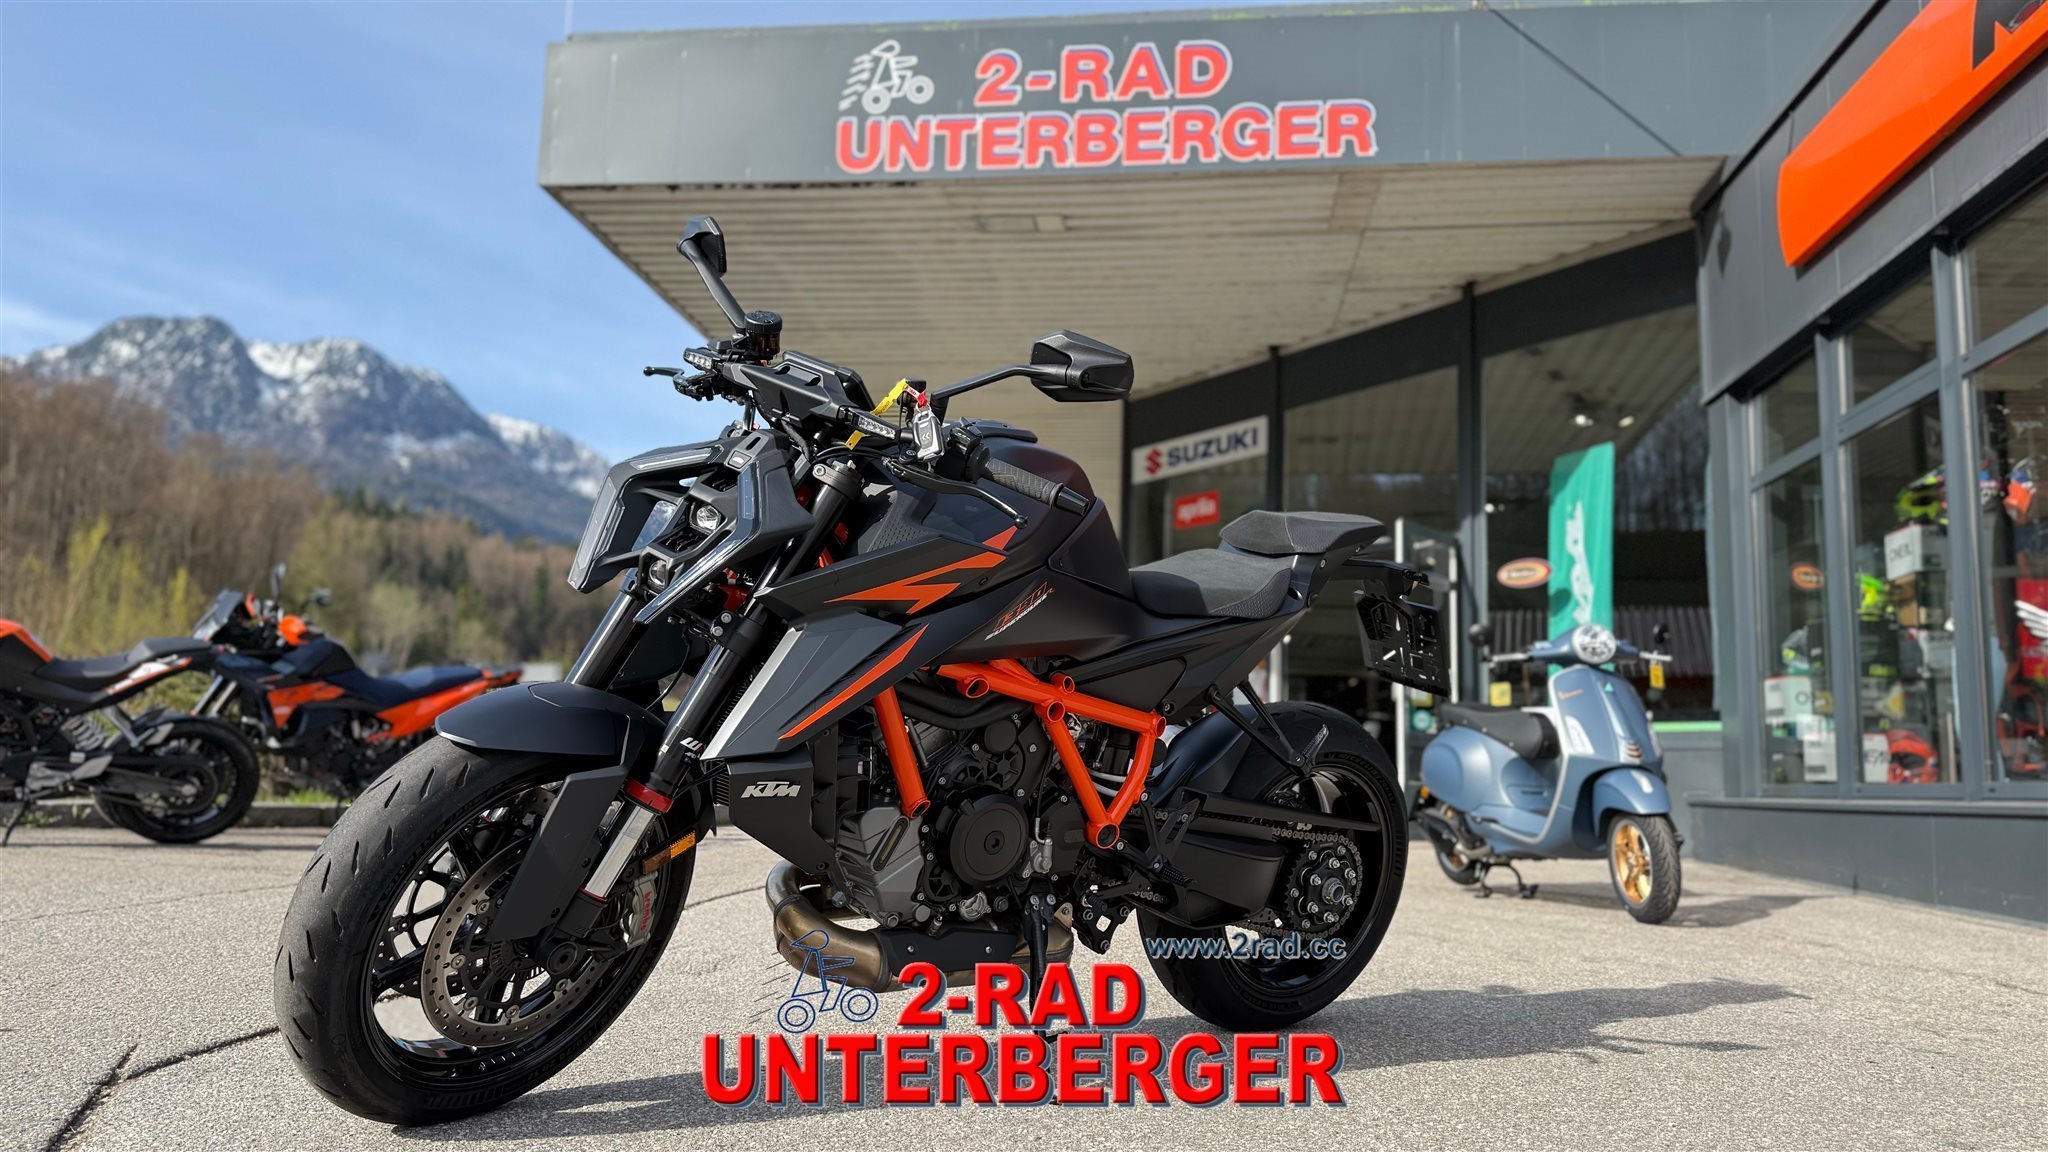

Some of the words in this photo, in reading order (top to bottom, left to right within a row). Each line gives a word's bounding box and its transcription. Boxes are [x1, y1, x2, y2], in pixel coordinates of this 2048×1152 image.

[974, 39, 1232, 107] 2-RAD
[835, 98, 1378, 174] UNTERBERGER
[1168, 427, 1259, 467] SUZUKI
[740, 781, 801, 798] KTM
[640, 891, 652, 932] brembo
